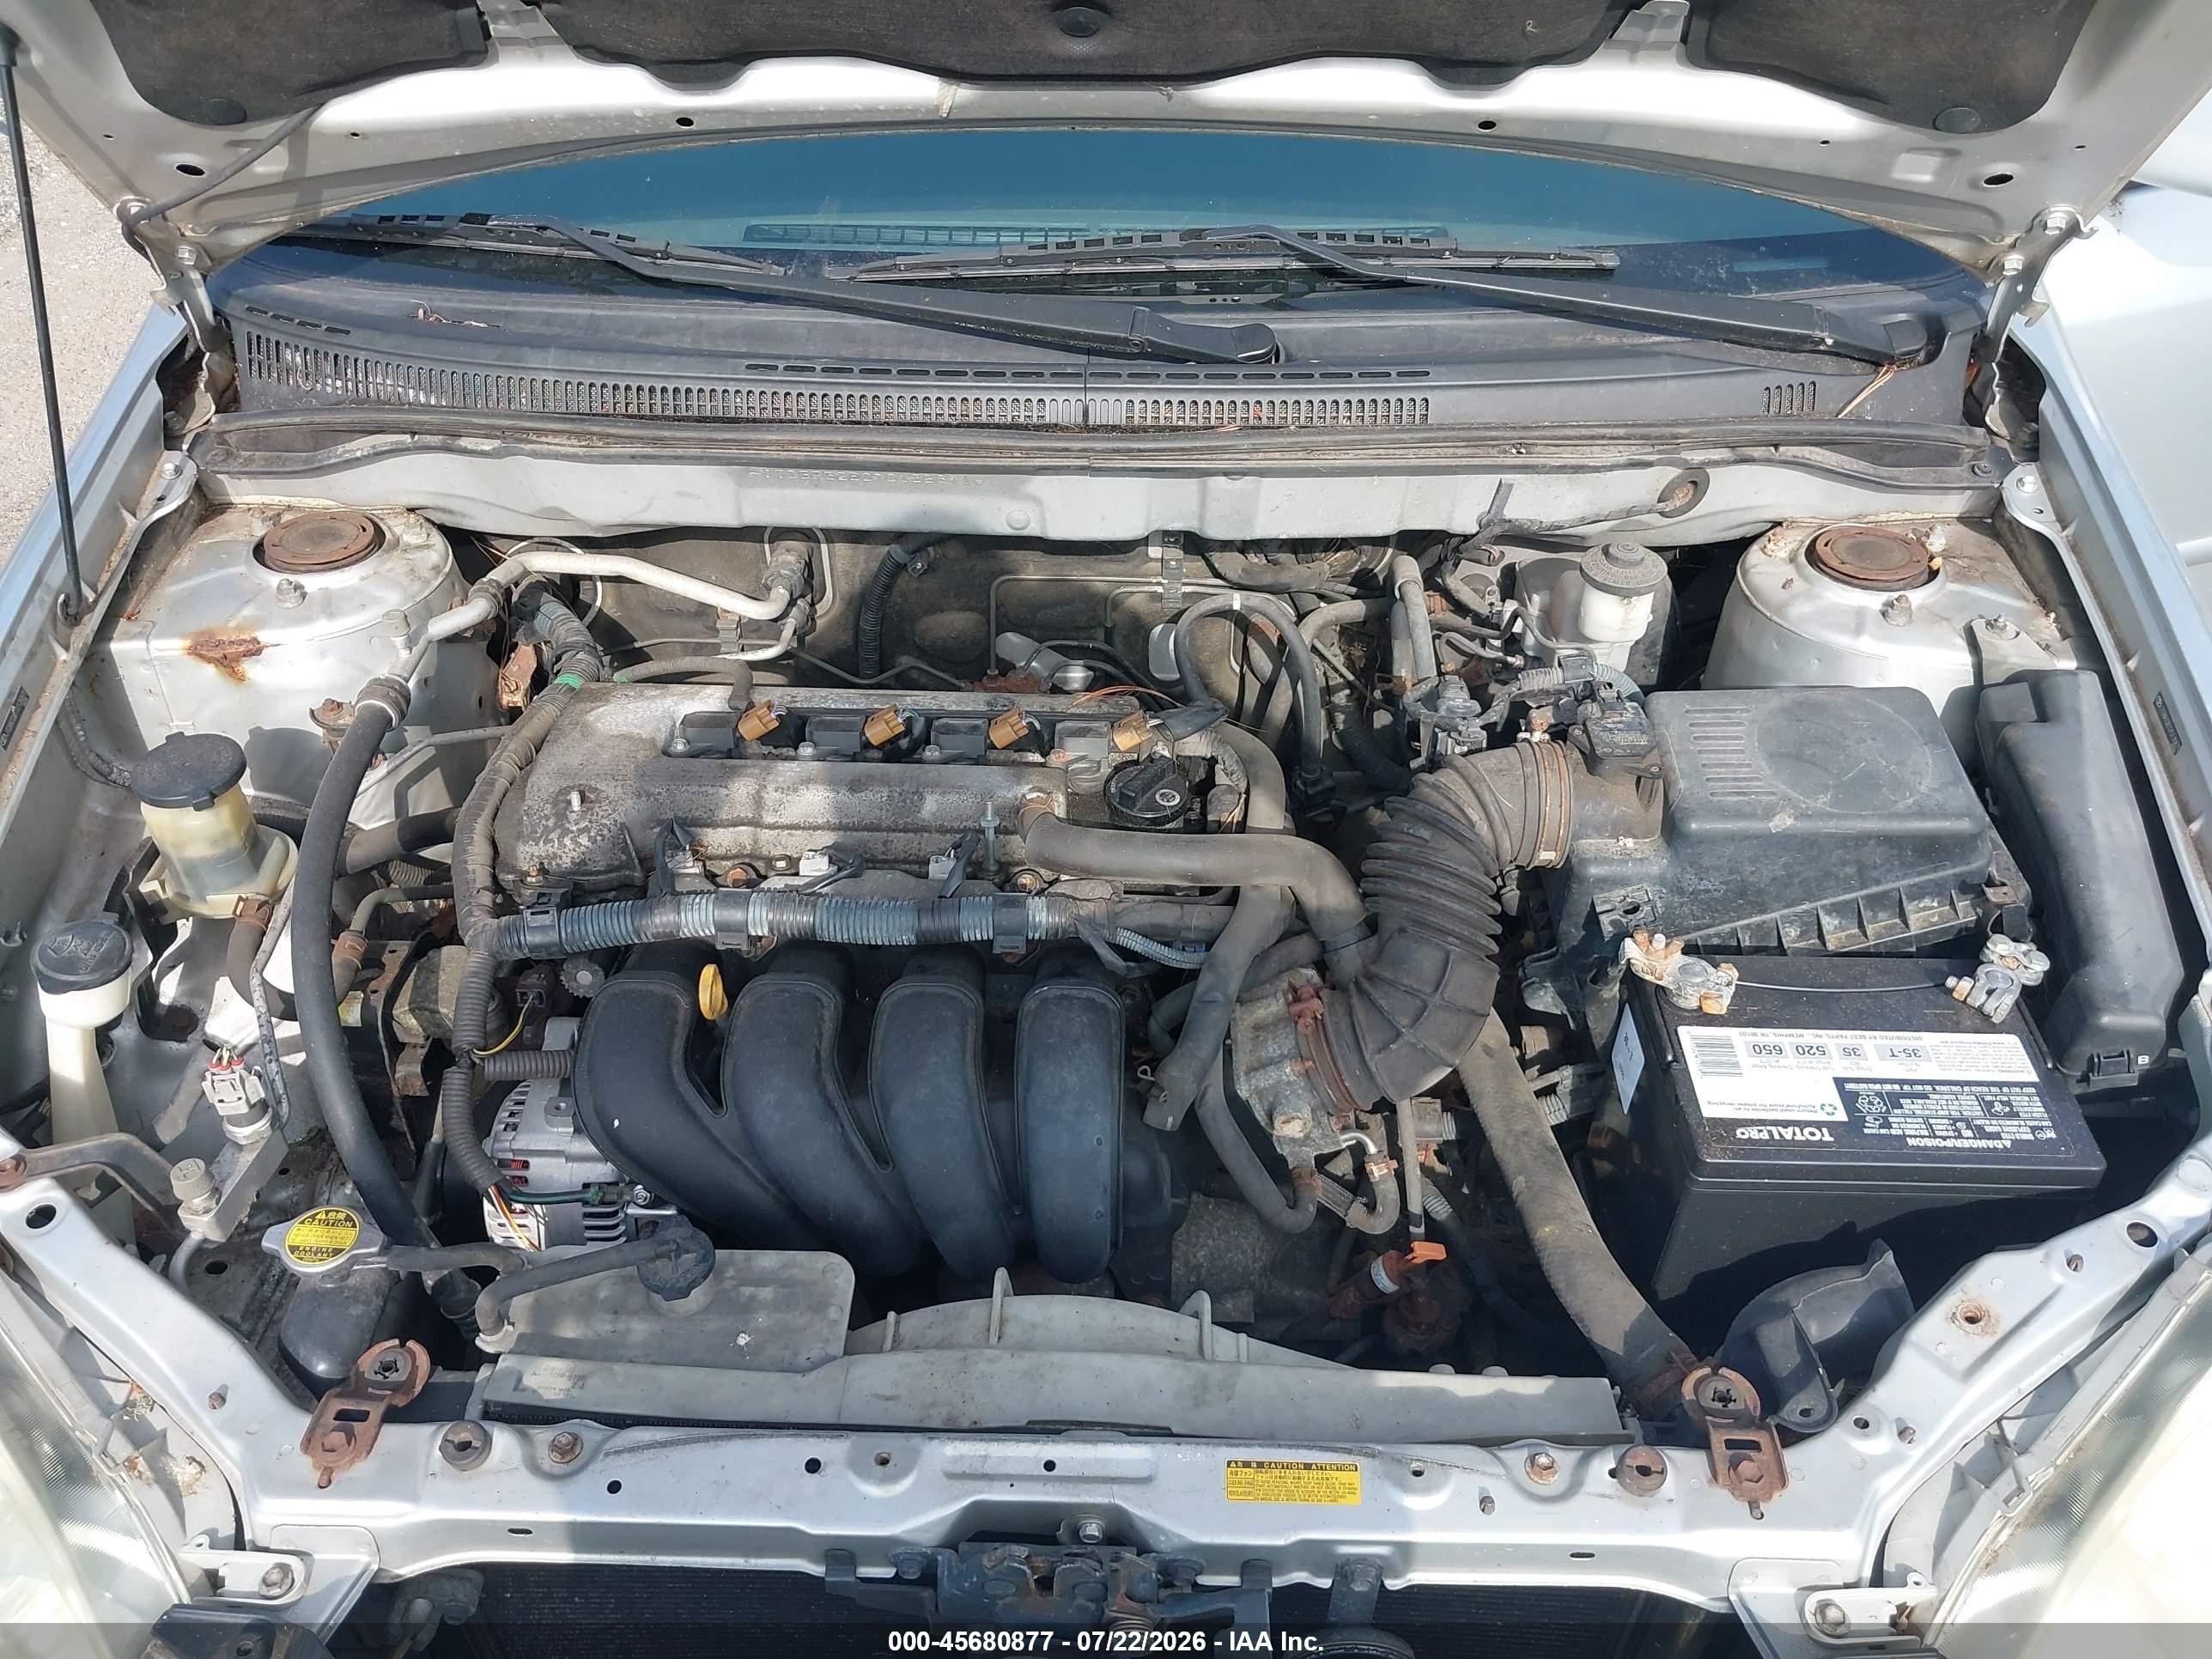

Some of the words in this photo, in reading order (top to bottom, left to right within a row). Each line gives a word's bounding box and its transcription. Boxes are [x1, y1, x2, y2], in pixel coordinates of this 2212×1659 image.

[1752, 1044, 1783, 1054] 650
[1796, 1045, 1826, 1055] 520
[1843, 1047, 1861, 1057] 35
[1889, 1048, 1922, 1058] 35-T
[2138, 1055, 2149, 1065] B
[1735, 1127, 1834, 1141] TOTALPRO
[1905, 1138, 2004, 1149] DANGER/POISON
[304, 1218, 354, 1227] CAUTION
